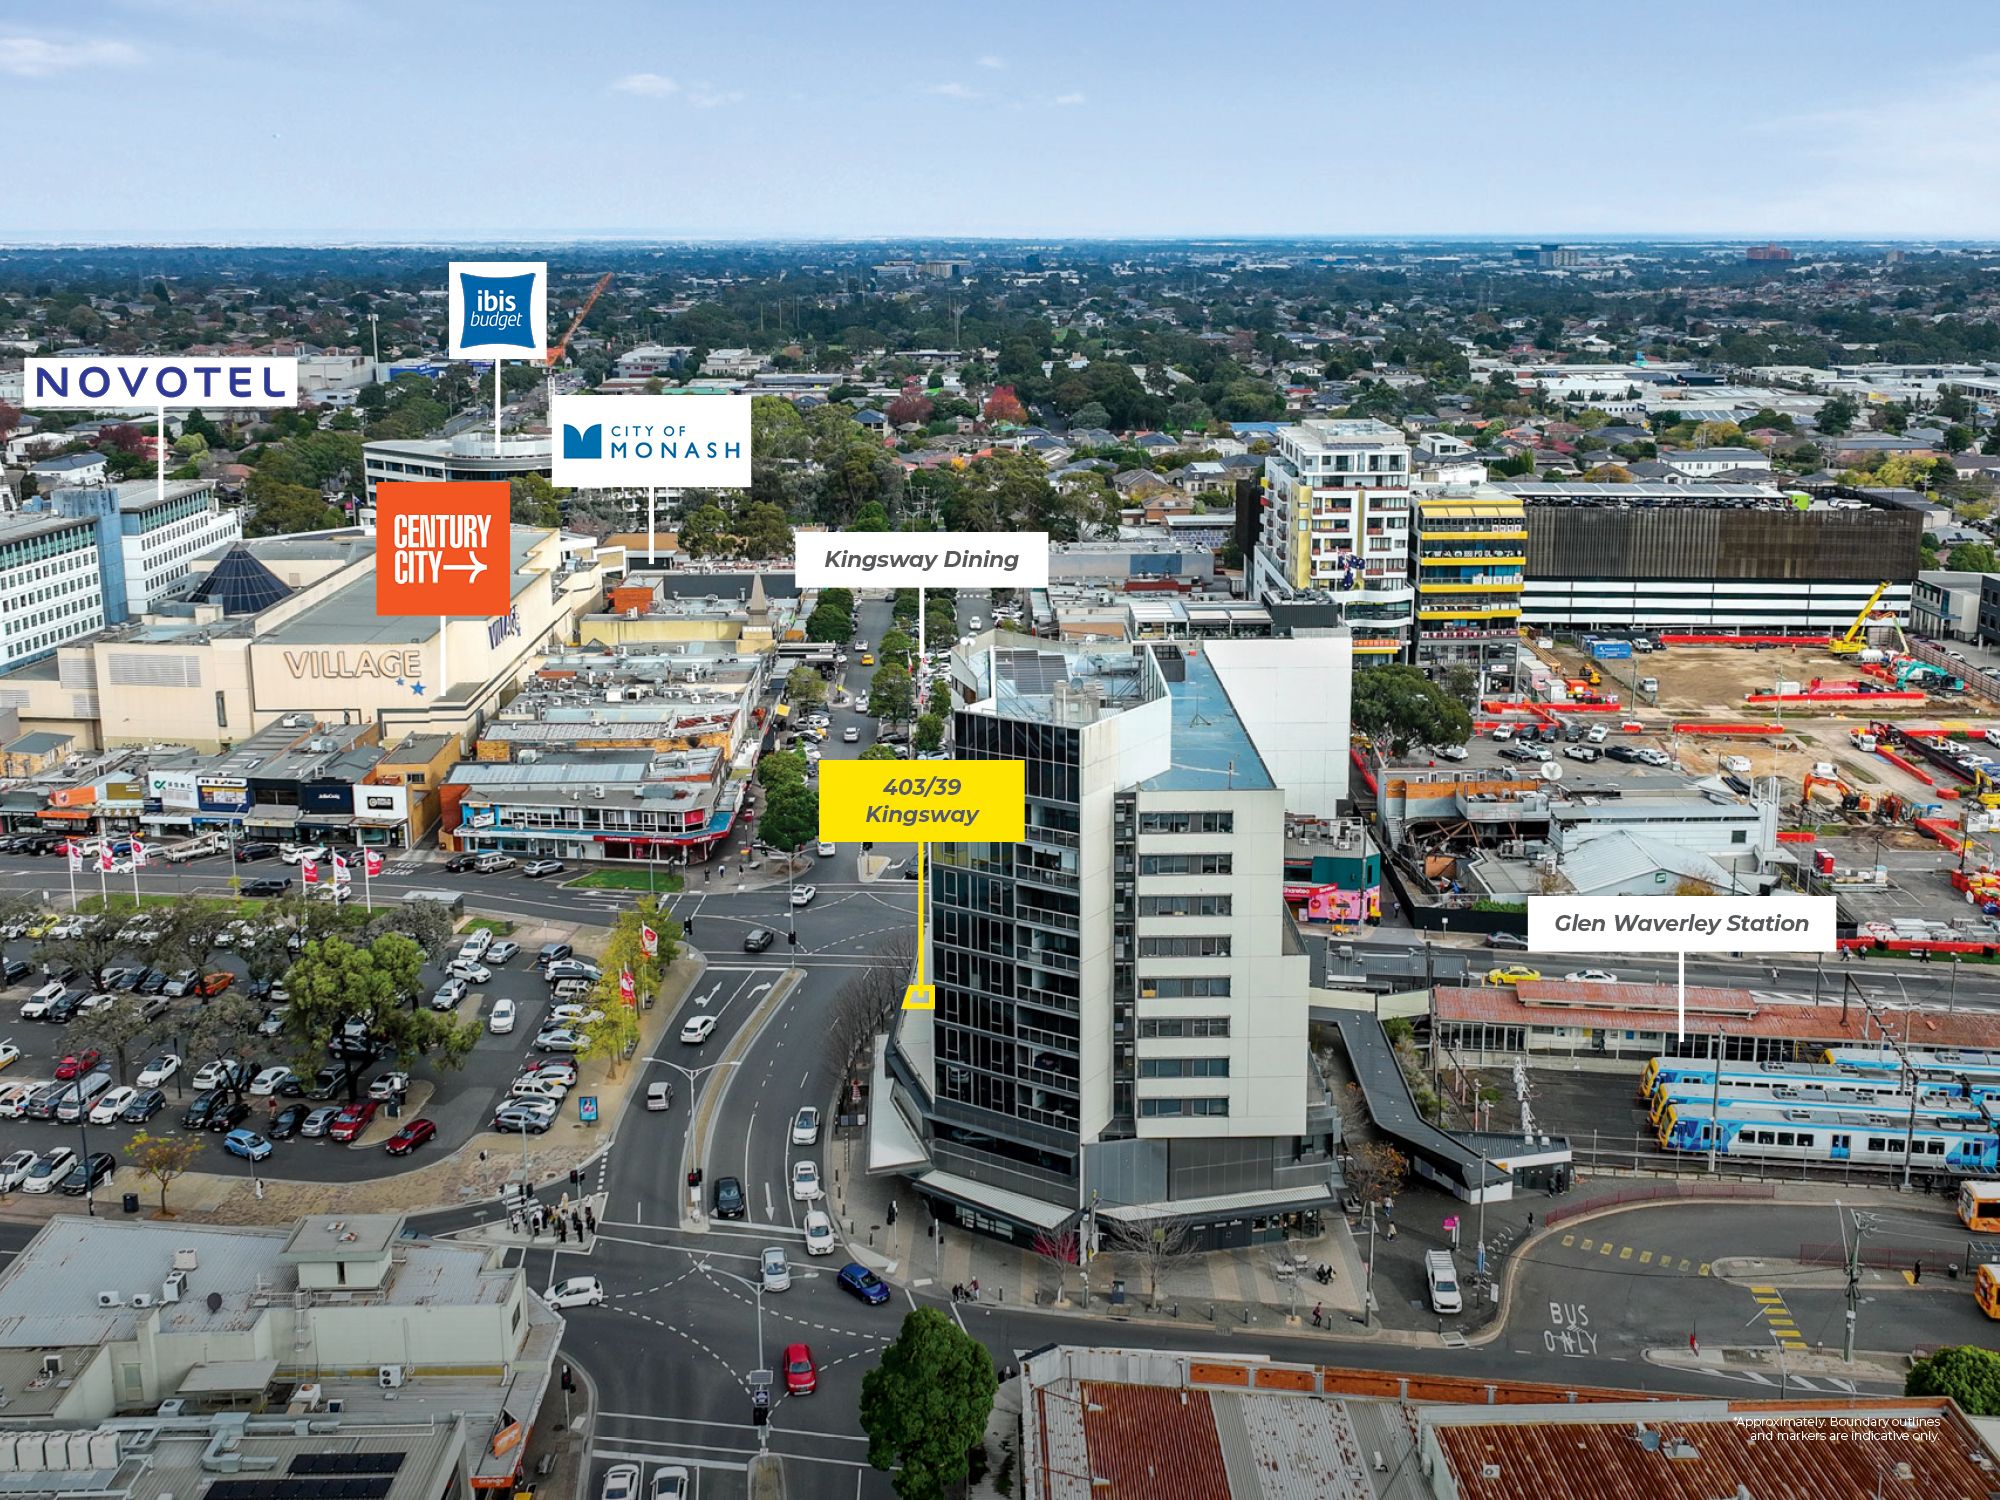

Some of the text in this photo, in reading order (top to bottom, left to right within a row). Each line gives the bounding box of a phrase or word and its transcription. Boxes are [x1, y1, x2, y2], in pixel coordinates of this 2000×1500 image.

[284, 650, 421, 678] VILLAGE
[1549, 1302, 1589, 1326] BUS
[1544, 1330, 1597, 1355] ONLY
